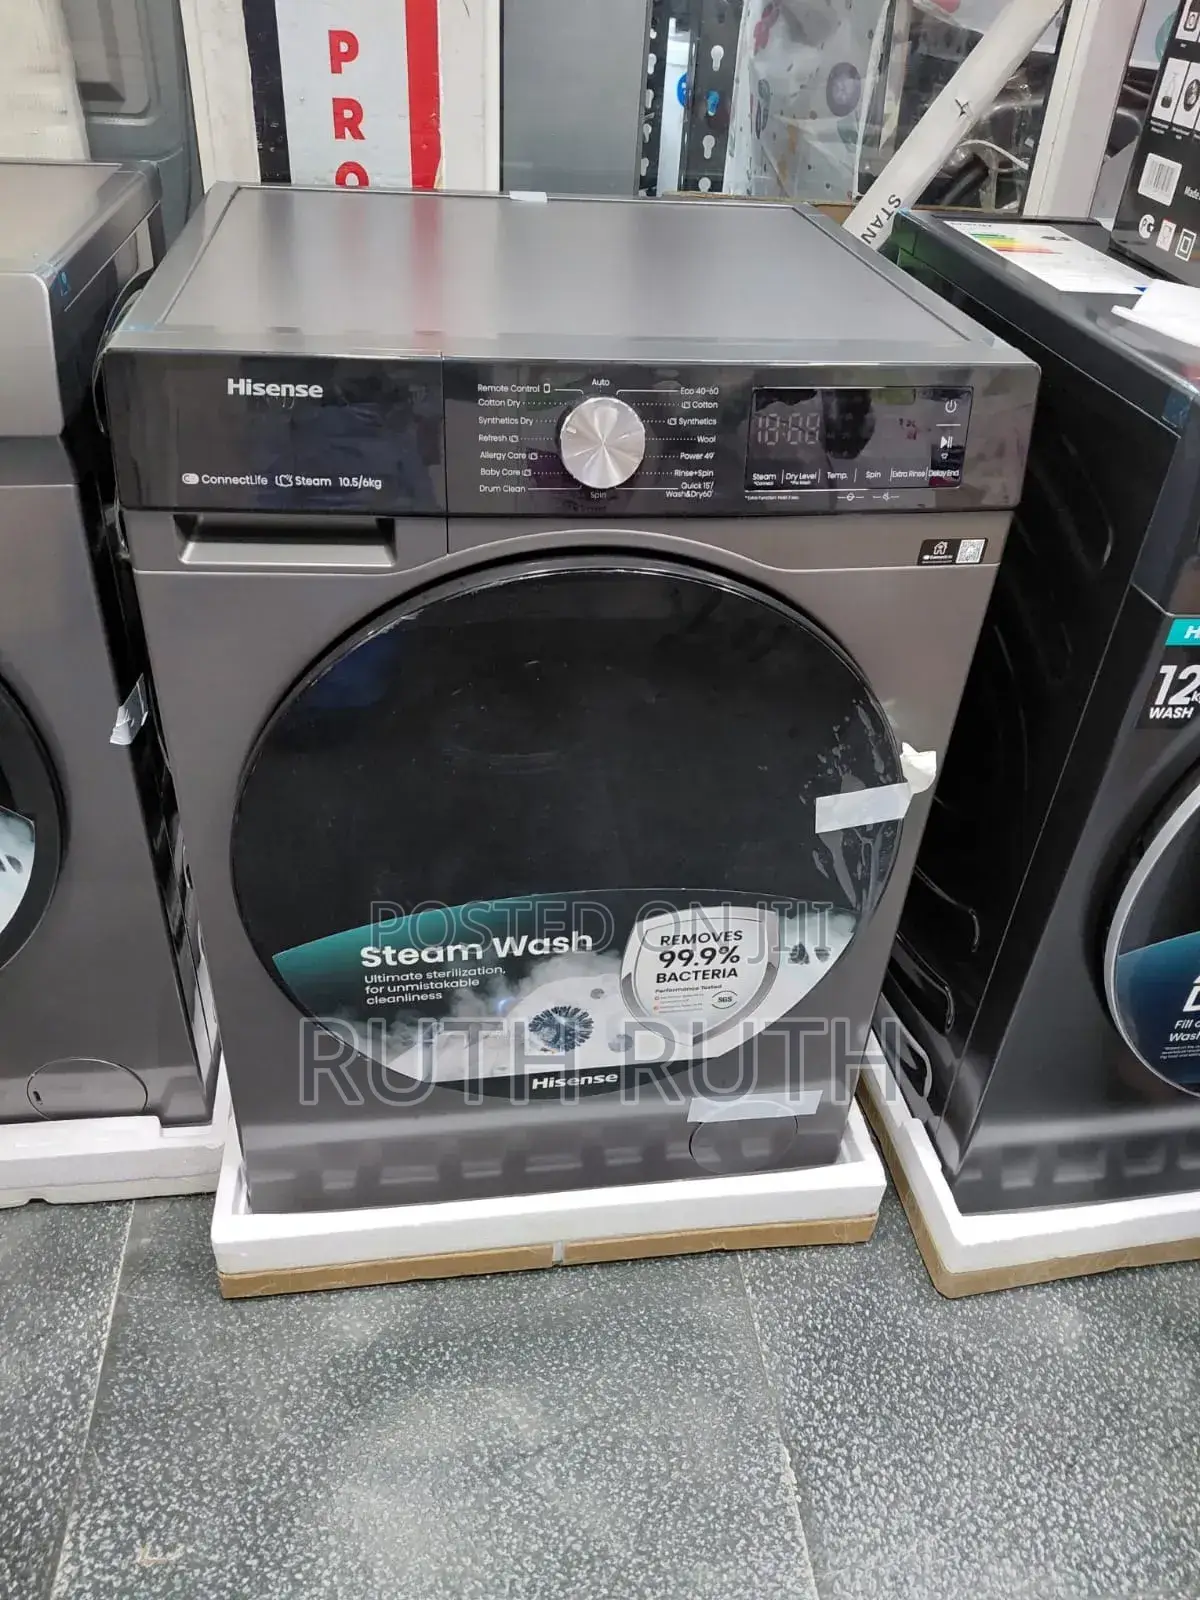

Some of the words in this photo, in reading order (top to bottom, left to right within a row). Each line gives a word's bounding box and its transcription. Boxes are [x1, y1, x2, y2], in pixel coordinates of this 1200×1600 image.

[861, 194, 902, 244] STAN
[227, 378, 323, 398] Hisense
[477, 383, 509, 392] Remote
[510, 384, 540, 393] Control
[680, 387, 694, 395] Eco
[478, 398, 505, 407] Cotton
[507, 399, 520, 408] Dry
[692, 401, 718, 409] Cotton
[478, 416, 519, 426] Synthetics
[520, 417, 534, 426] Dry
[678, 417, 717, 426] Synthetics
[478, 434, 508, 442] Refresh
[697, 435, 716, 443] Wool
[480, 451, 506, 460] Allergy
[507, 451, 526, 459] Care
[680, 452, 703, 460] Power
[480, 468, 500, 477] Baby
[501, 468, 520, 476] Care
[674, 469, 714, 478] Rinse+Spin
[785, 473, 798, 481] Dry
[799, 472, 817, 480] Level
[827, 471, 848, 480] Temp.
[865, 471, 881, 479] Spin
[892, 470, 908, 478] Extra
[908, 470, 926, 478] Rinse
[928, 469, 947, 478] Delay
[201, 474, 268, 485] ConnectLife
[295, 475, 332, 487] Steam
[338, 475, 382, 490] 10.5/6kg
[479, 484, 501, 492] Drum
[502, 484, 526, 493] Clean
[590, 491, 607, 499] Spin
[1149, 707, 1194, 719] WASH
[660, 930, 743, 946] REMOVES
[360, 942, 483, 968] Steam
[492, 931, 593, 958] Wash
[658, 945, 741, 968] 99.9%
[364, 971, 424, 984] Ultimate
[426, 965, 506, 980] sterilization,
[656, 967, 738, 984] BACTERIA
[365, 984, 384, 994] for
[387, 978, 480, 993] unmistakable
[366, 991, 442, 1005] cleanliness
[1174, 1019, 1194, 1030] Fill
[532, 1073, 619, 1090] Hisense
